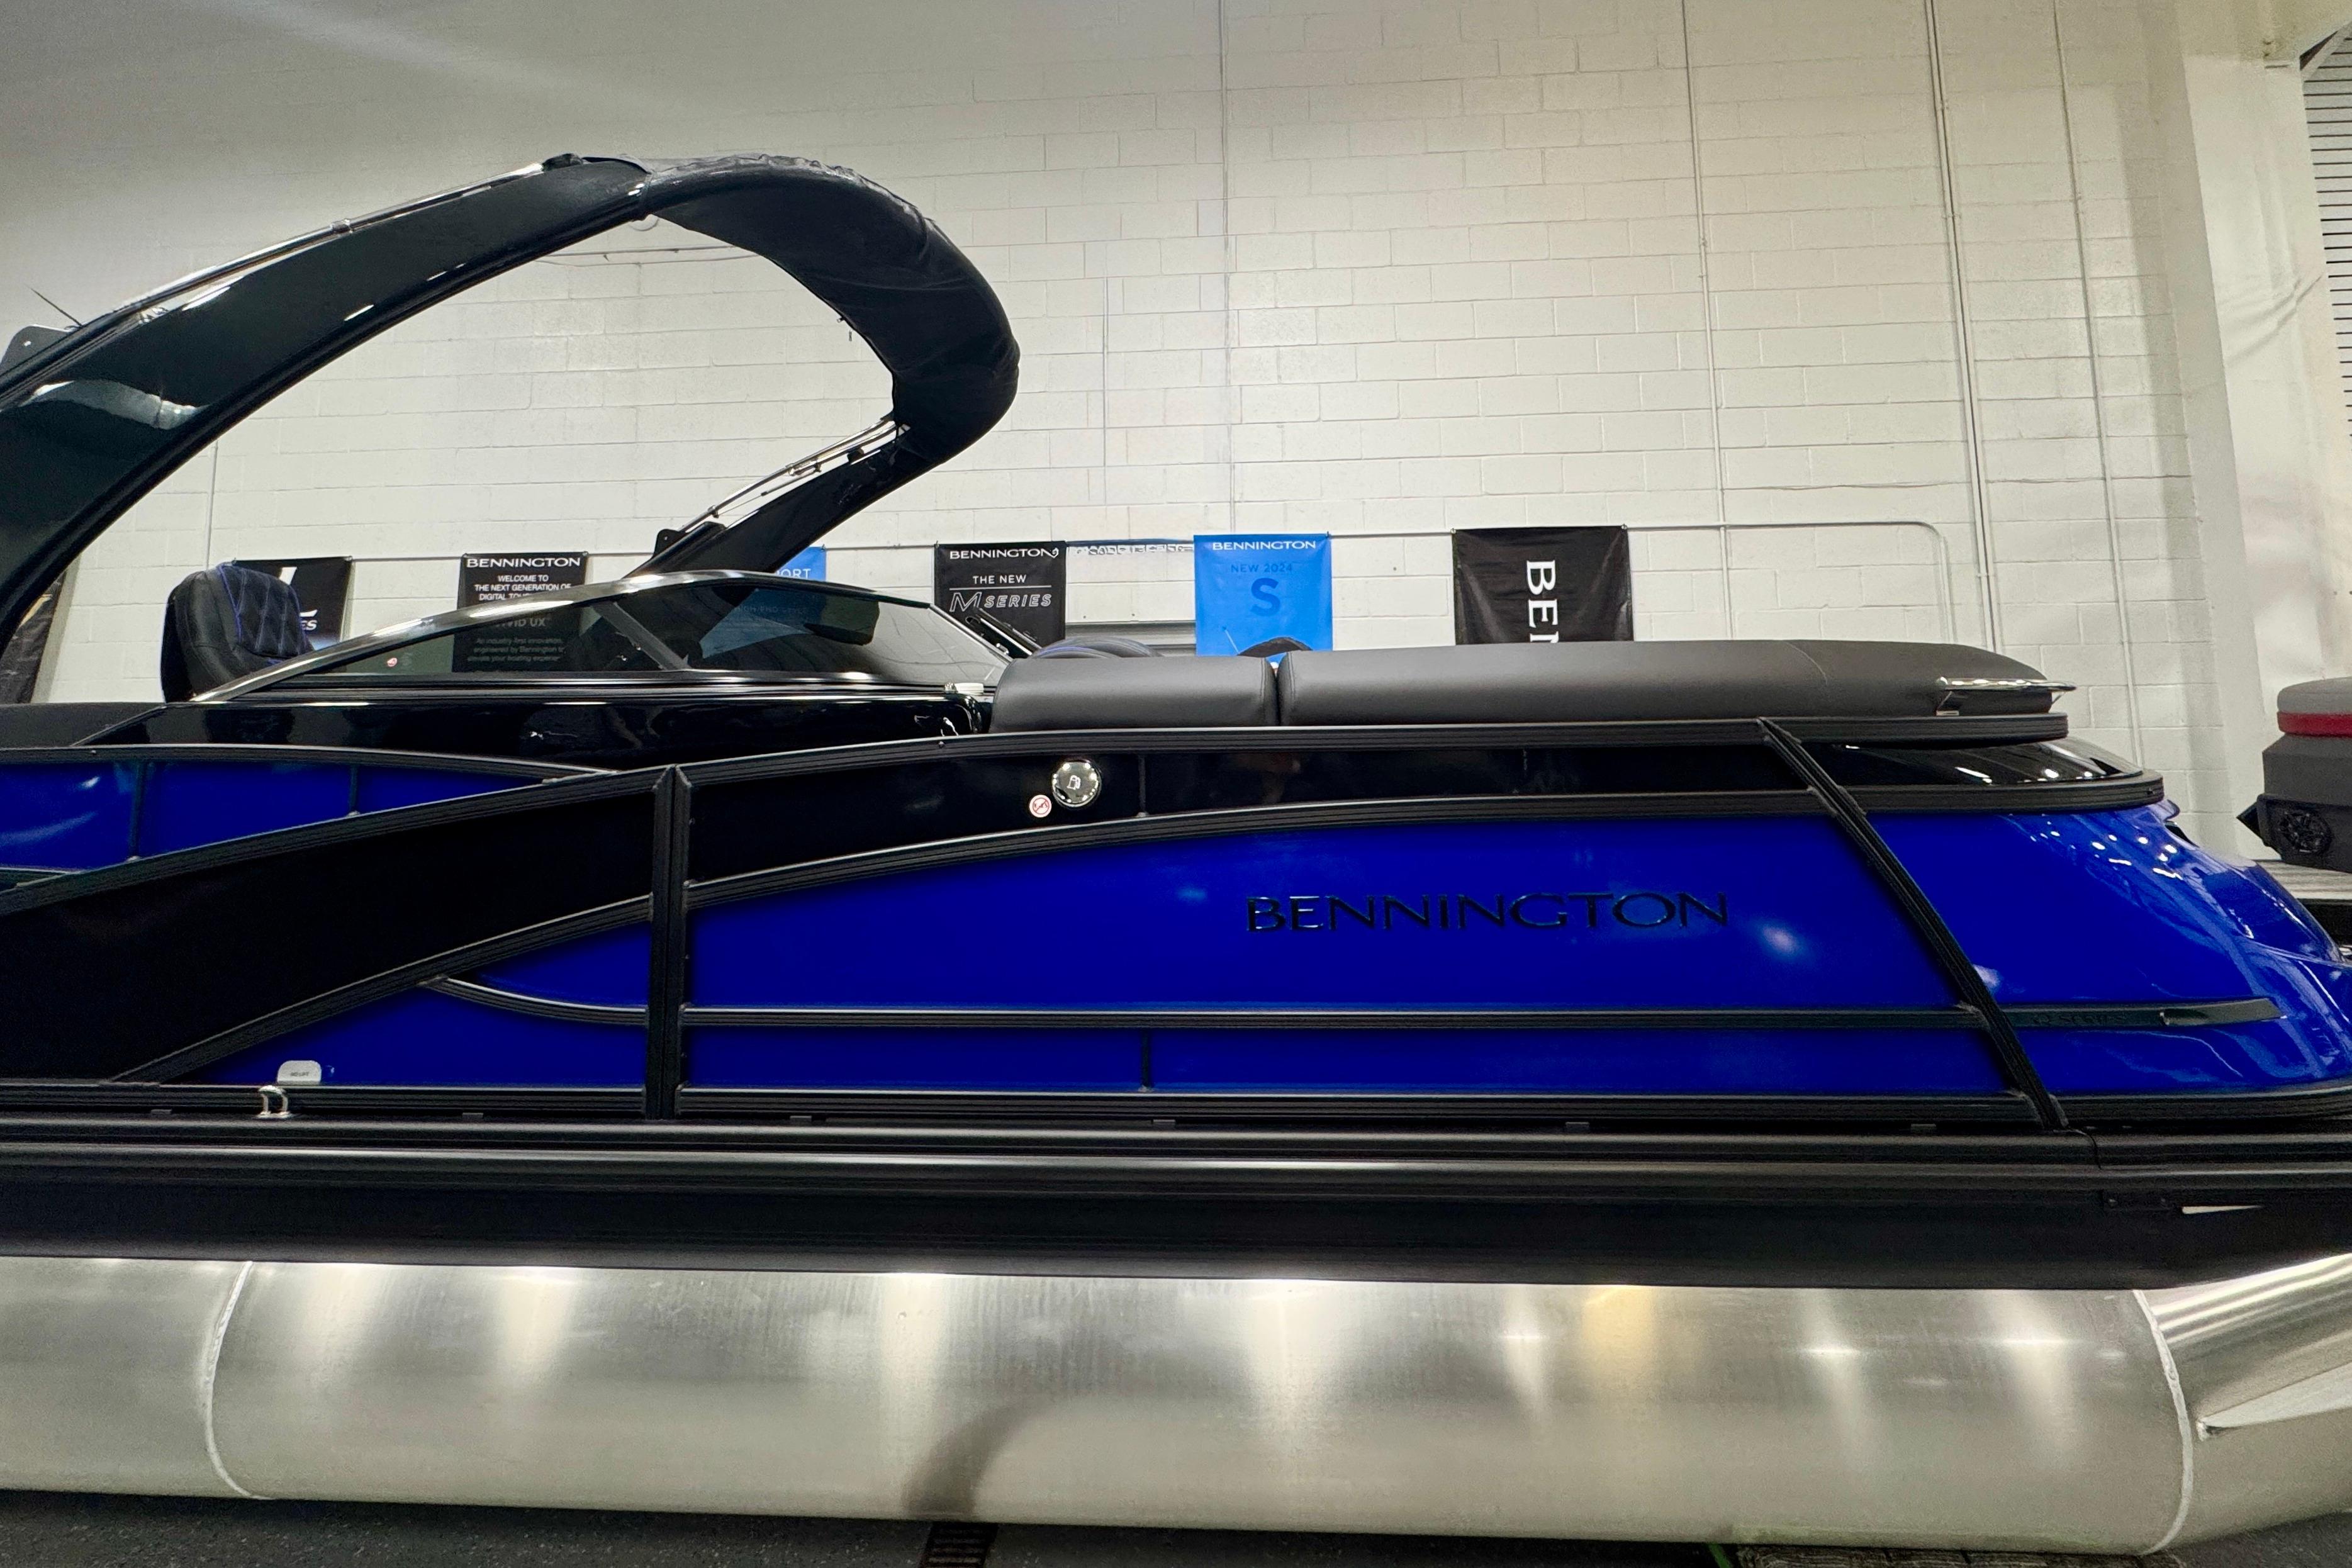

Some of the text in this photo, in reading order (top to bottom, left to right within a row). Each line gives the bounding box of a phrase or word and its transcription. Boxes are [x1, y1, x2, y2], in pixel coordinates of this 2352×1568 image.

[1212, 540, 1316, 551] BENNINGTON
[949, 547, 1060, 559] BENNINGTON
[466, 557, 581, 568] BENNINGTON
[1231, 563, 1292, 573] NEW 2024
[973, 574, 1027, 585] THE NEW
[983, 594, 1052, 608] SERIES
[1250, 578, 1281, 617] S
[1246, 891, 1728, 932] BENNINGTON
